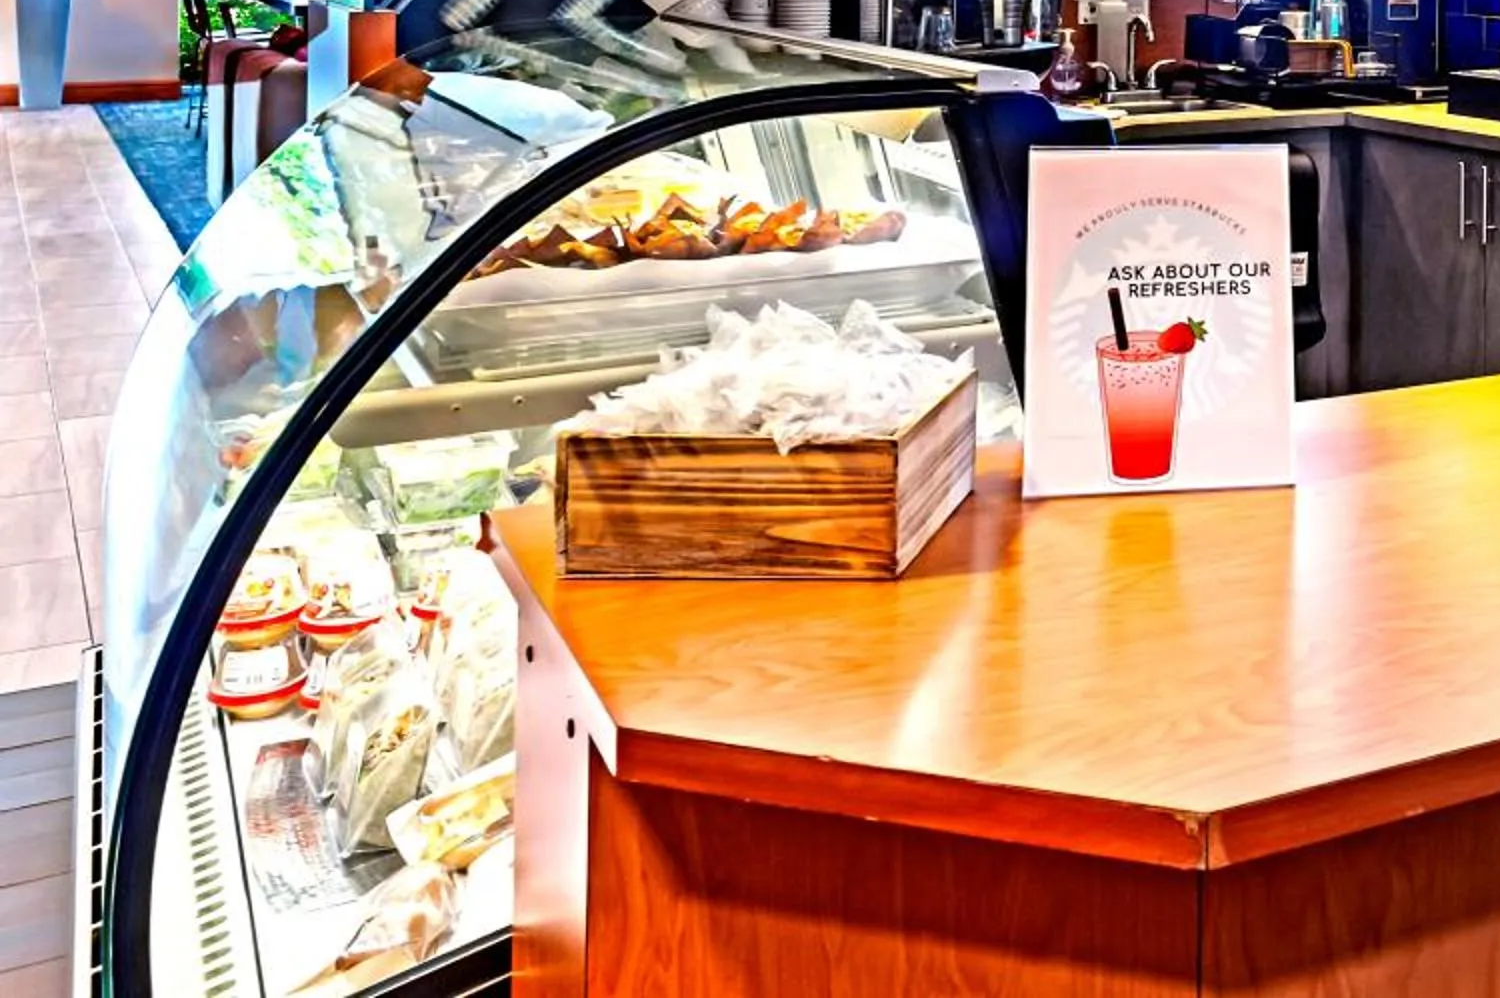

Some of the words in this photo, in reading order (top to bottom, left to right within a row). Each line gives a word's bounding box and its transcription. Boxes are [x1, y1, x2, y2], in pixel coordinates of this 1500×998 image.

[1091, 202, 1137, 226] PROUDLY
[1140, 197, 1178, 207] SERVE
[1183, 199, 1247, 235] STARBUCKS
[1107, 266, 1145, 281] ASK
[1152, 263, 1221, 280] ABOUT
[1228, 261, 1271, 277] OUR
[1128, 280, 1251, 298] REFRESHERS
